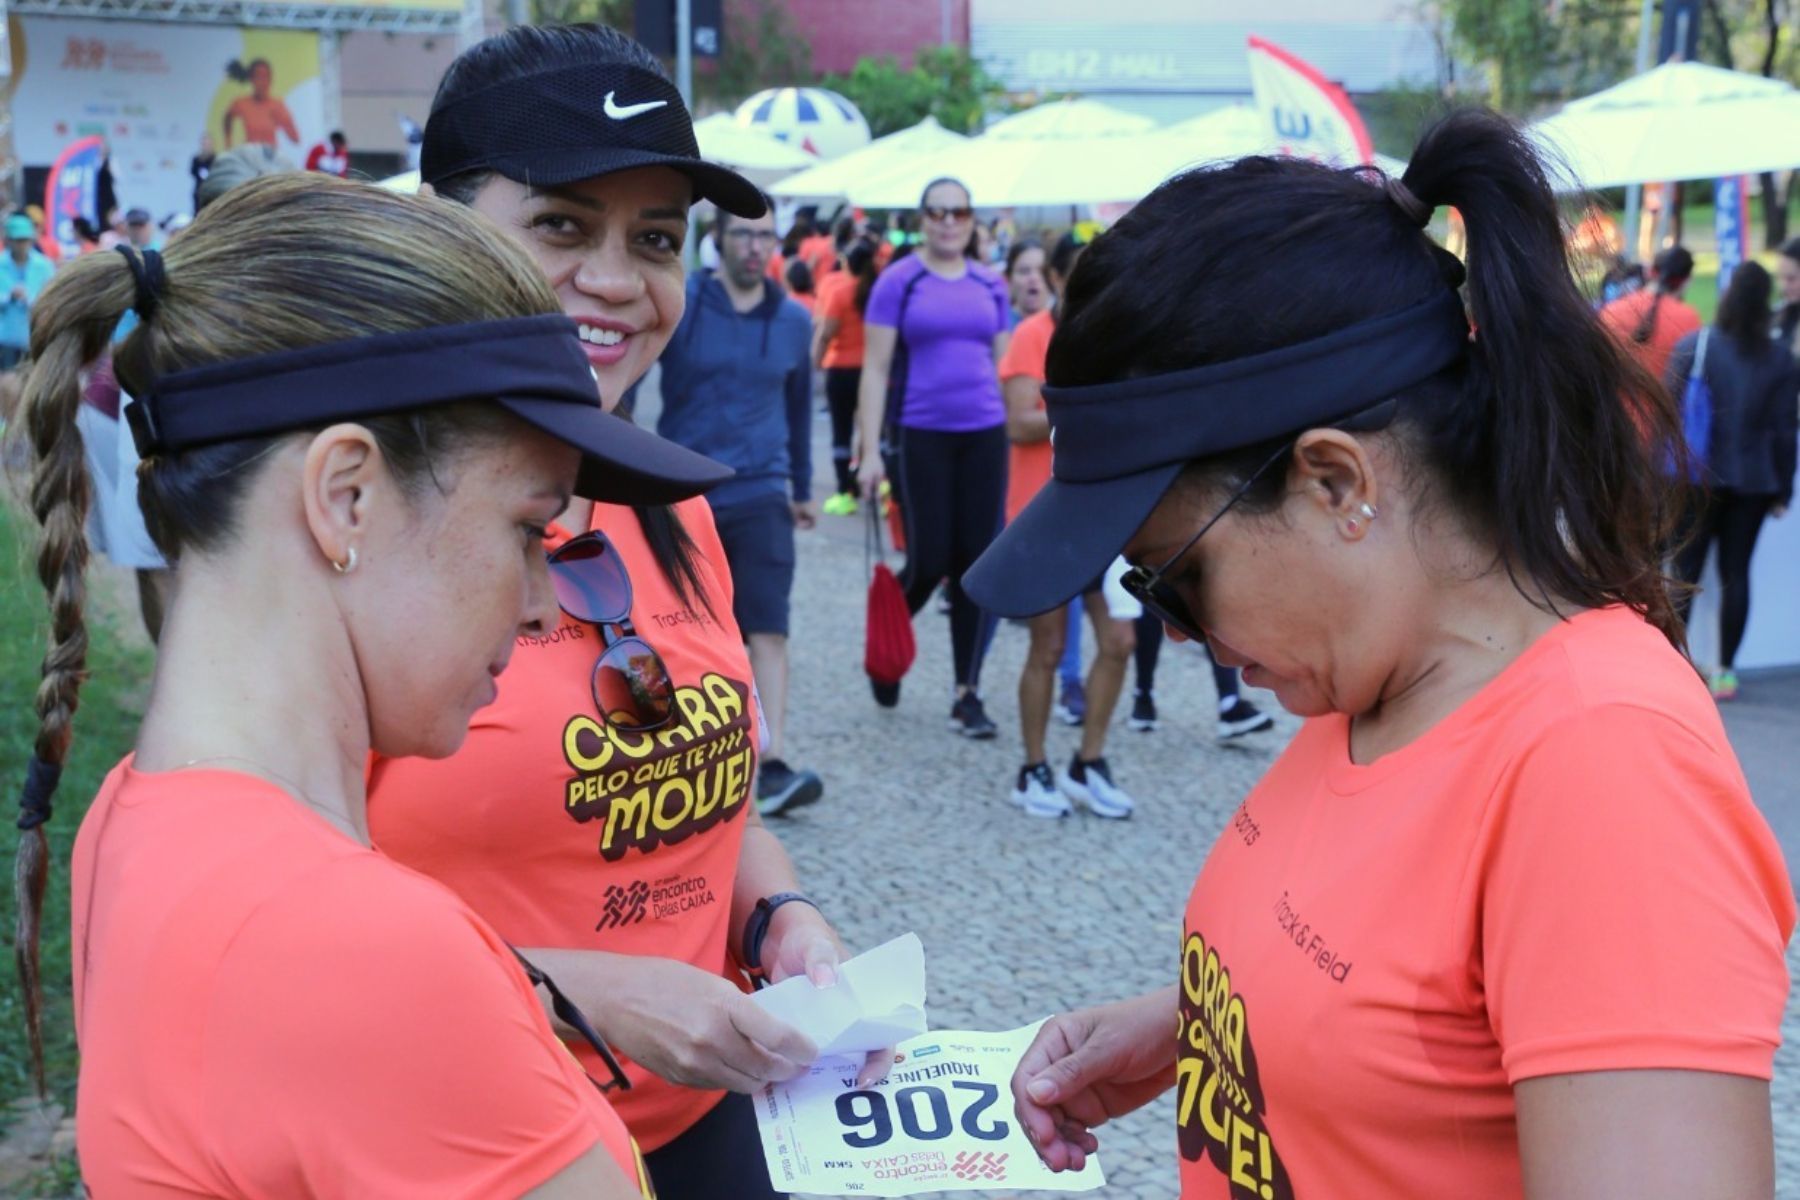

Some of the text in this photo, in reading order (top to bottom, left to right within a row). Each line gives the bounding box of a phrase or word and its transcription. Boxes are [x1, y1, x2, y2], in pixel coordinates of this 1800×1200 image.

[568, 743, 706, 807] PELO QUE TE
[652, 876, 706, 902] encontro
[653, 890, 716, 920] Delas CAIXA
[892, 1061, 980, 1084] JAQUELINE
[833, 1079, 1011, 1149] 206
[861, 1153, 909, 1169] CAIXA
[874, 1161, 948, 1180] encontro
